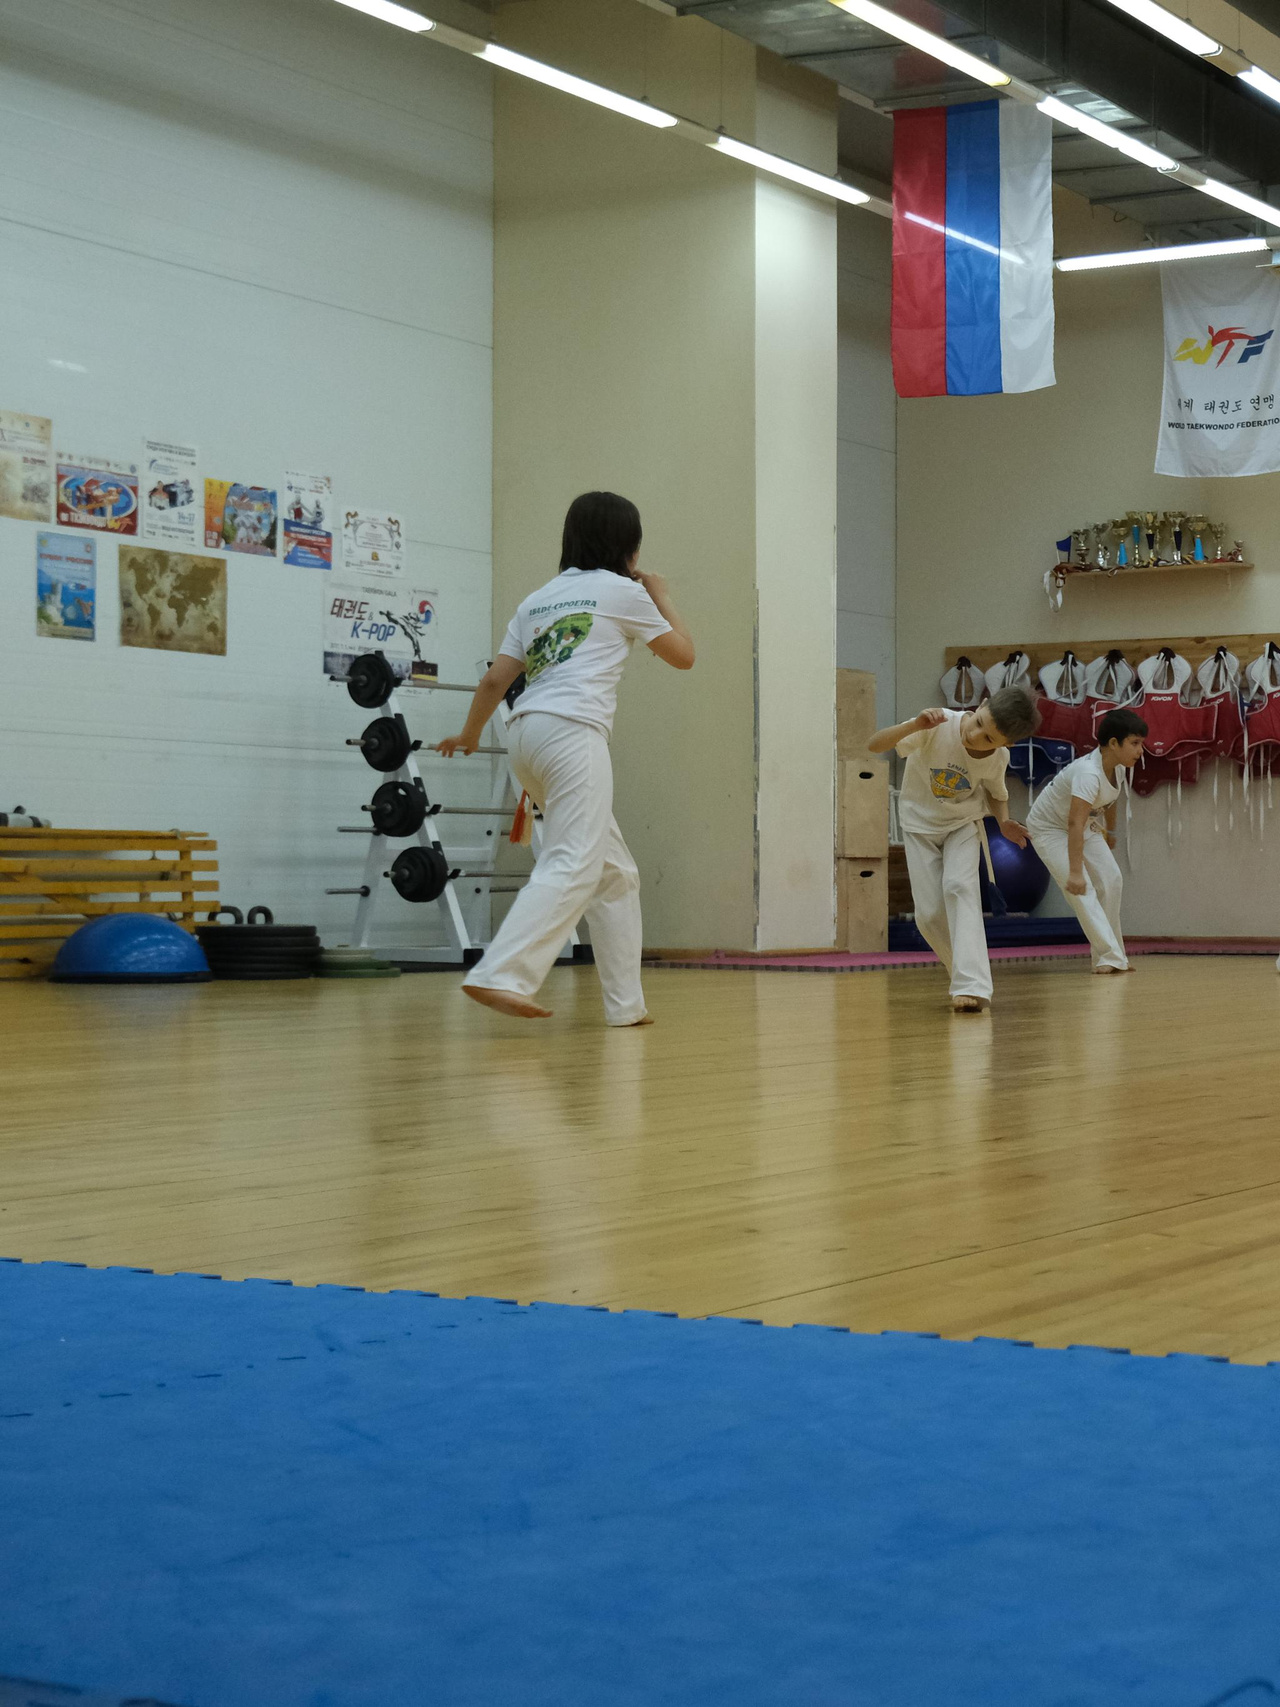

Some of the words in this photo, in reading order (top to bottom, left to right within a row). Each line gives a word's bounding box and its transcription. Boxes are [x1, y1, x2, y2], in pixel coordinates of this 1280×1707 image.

[1187, 423, 1235, 431] TAEKWONDO
[330, 598, 370, 621] 태권도
[351, 621, 396, 642] K-POP
